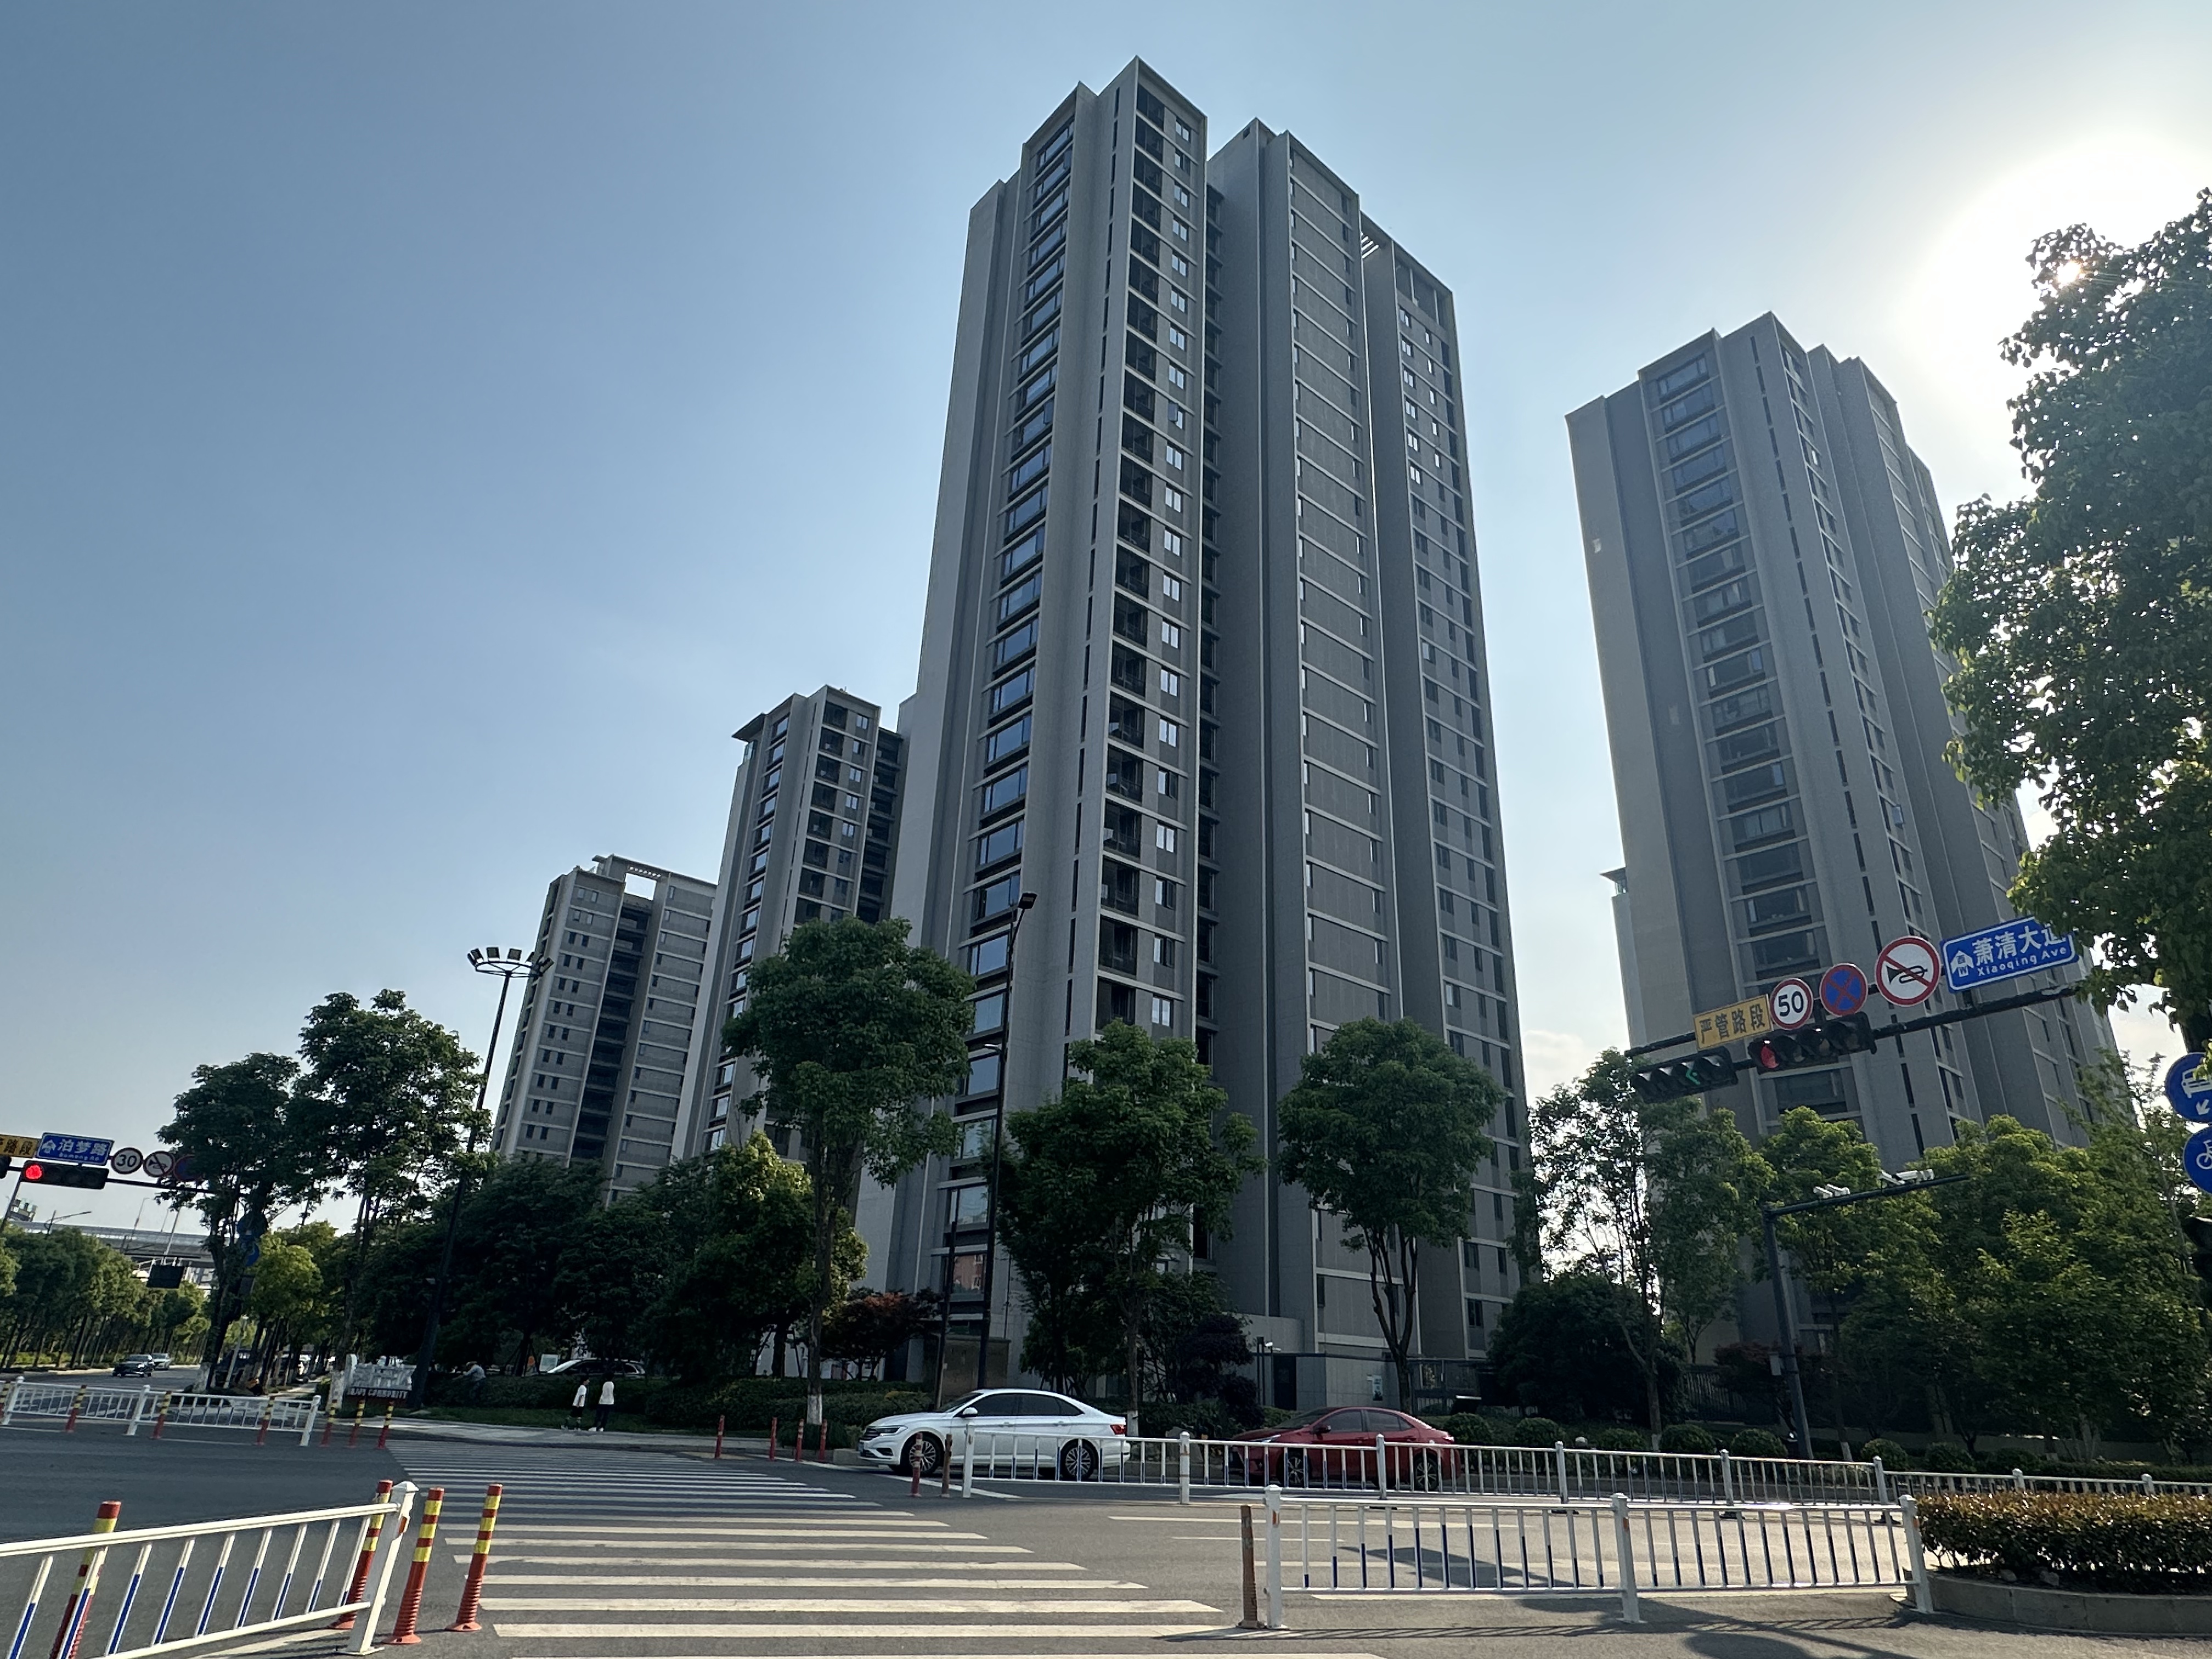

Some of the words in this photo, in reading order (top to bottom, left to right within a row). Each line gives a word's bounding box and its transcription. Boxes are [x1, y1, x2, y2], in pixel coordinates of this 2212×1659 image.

[1977, 954, 2038, 977] Xiaoqing
[2041, 947, 2067, 960] Ave
[1778, 991, 1804, 1017] 50
[1699, 1003, 1765, 1044] 严管路段
[0, 1138, 33, 1155] 路段
[58, 1139, 108, 1156] 泊梦路
[116, 1154, 137, 1167] 30
